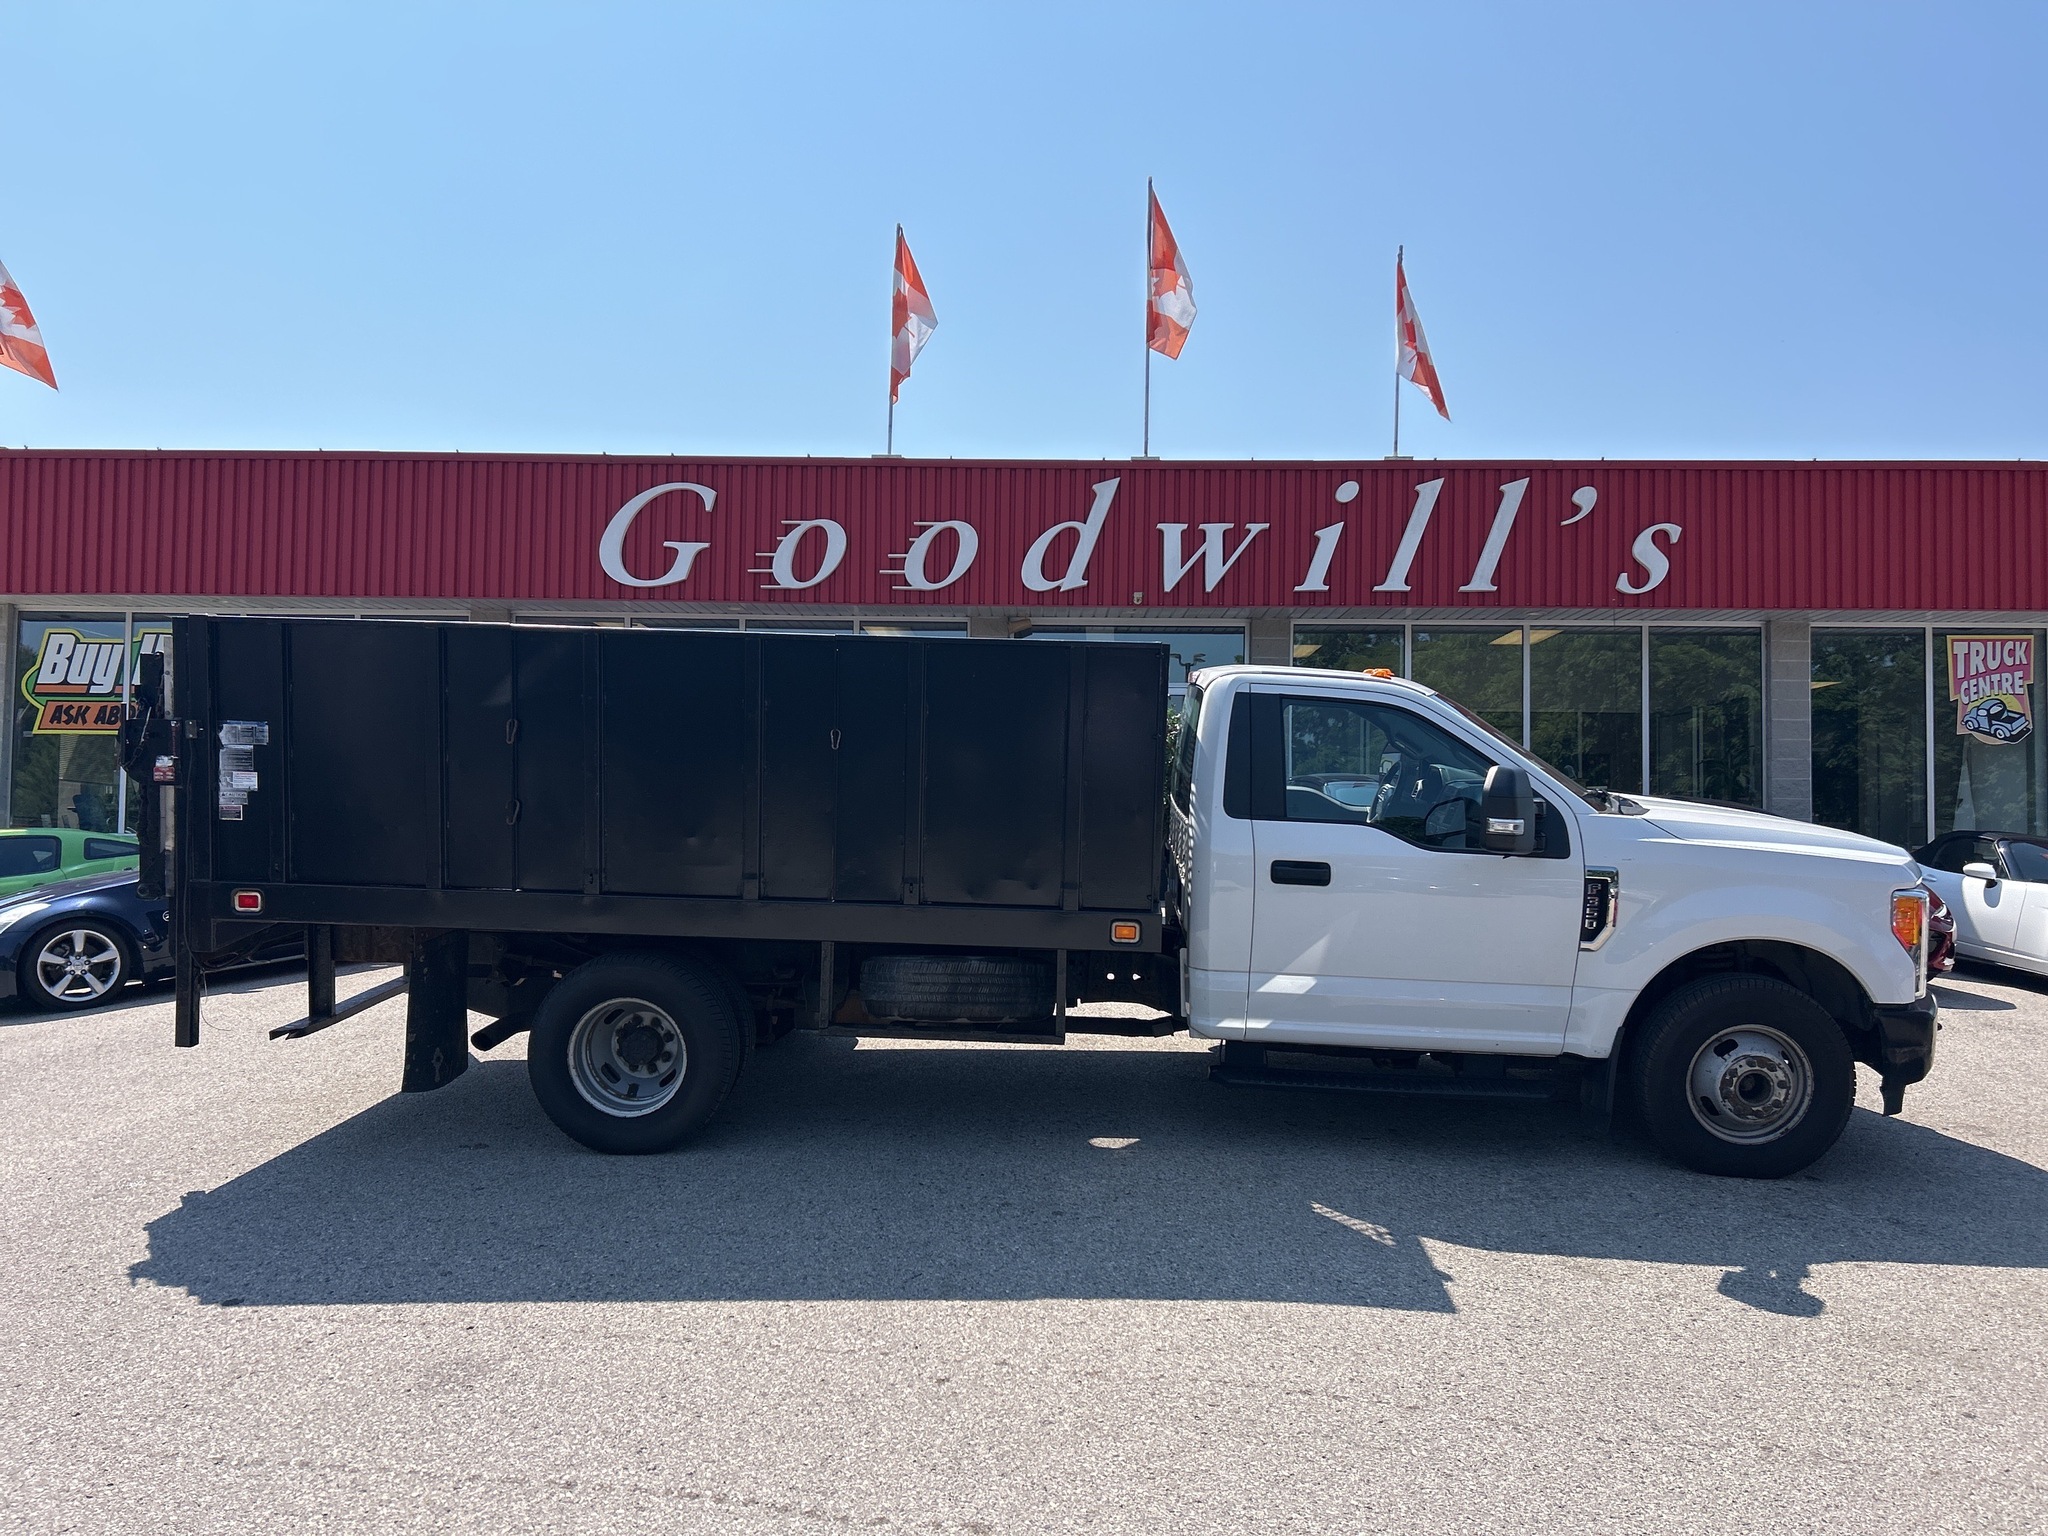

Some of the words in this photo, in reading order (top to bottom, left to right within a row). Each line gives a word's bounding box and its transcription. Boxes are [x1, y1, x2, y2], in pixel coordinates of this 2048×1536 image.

[37, 634, 124, 694] Buy
[1953, 640, 2028, 679] TRUCK
[1960, 671, 2024, 704] CENTRE
[49, 705, 91, 725] ASK
